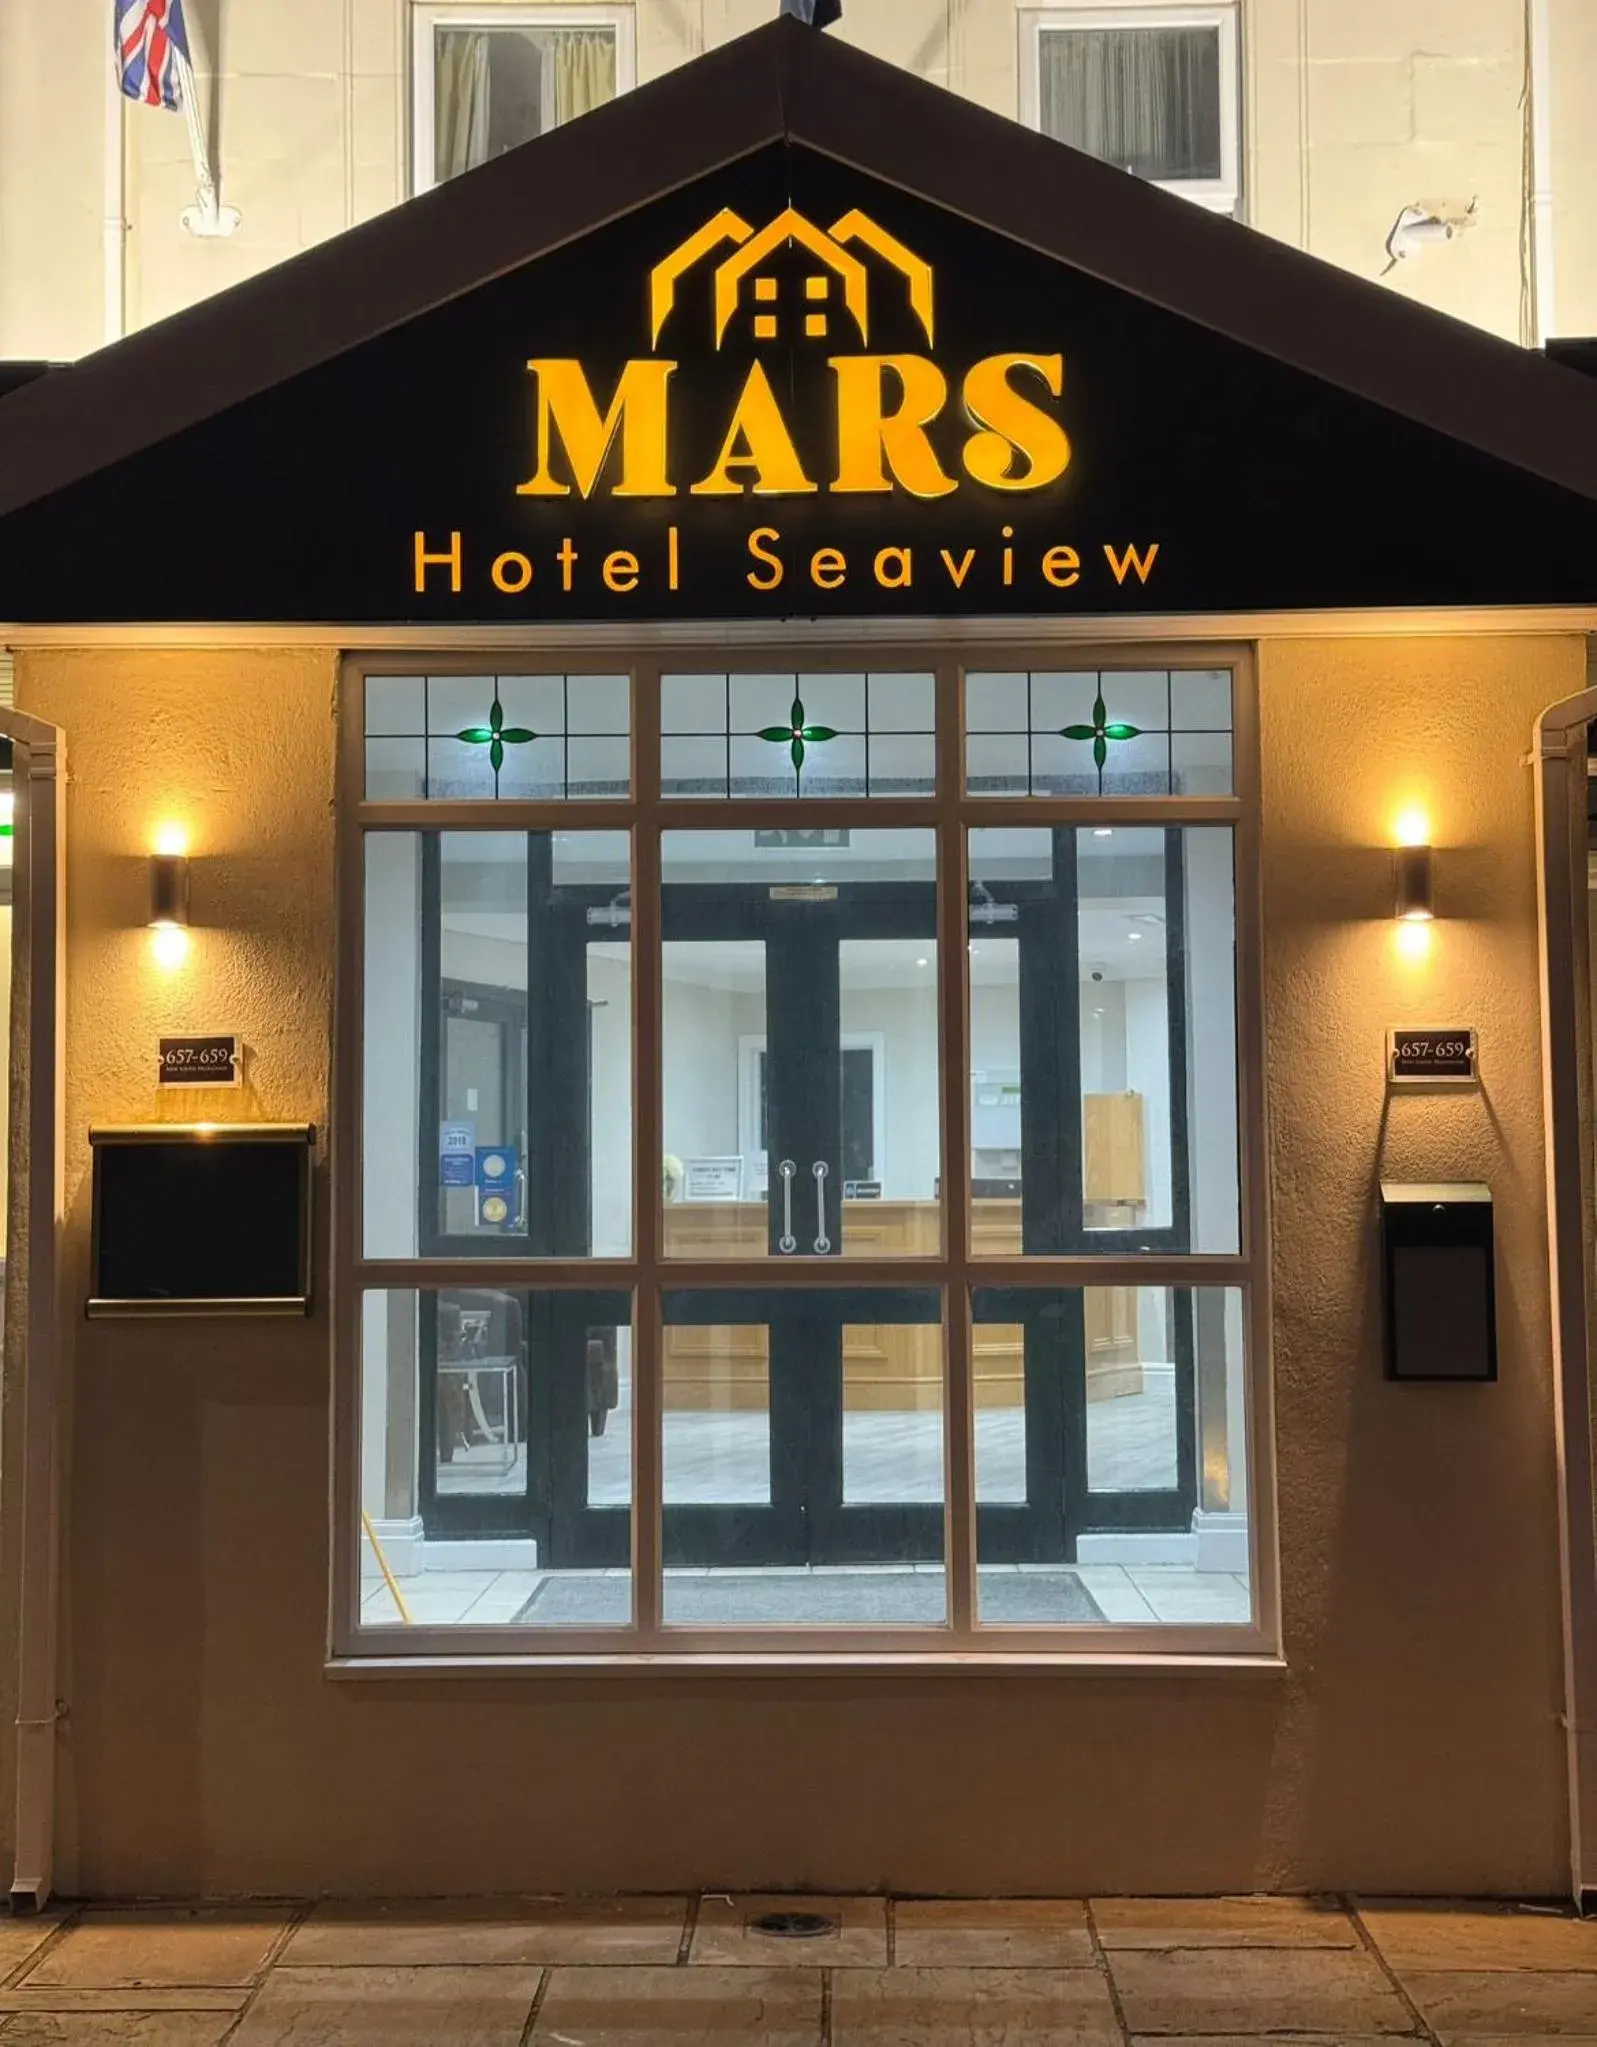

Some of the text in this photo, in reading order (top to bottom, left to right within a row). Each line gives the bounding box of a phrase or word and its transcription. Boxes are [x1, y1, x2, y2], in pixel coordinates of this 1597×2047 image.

[517, 354, 1070, 499] MARS
[415, 527, 1158, 592] Hotel Seaview
[166, 1048, 228, 1064] 657-659
[1401, 1042, 1464, 1057] 657-659
